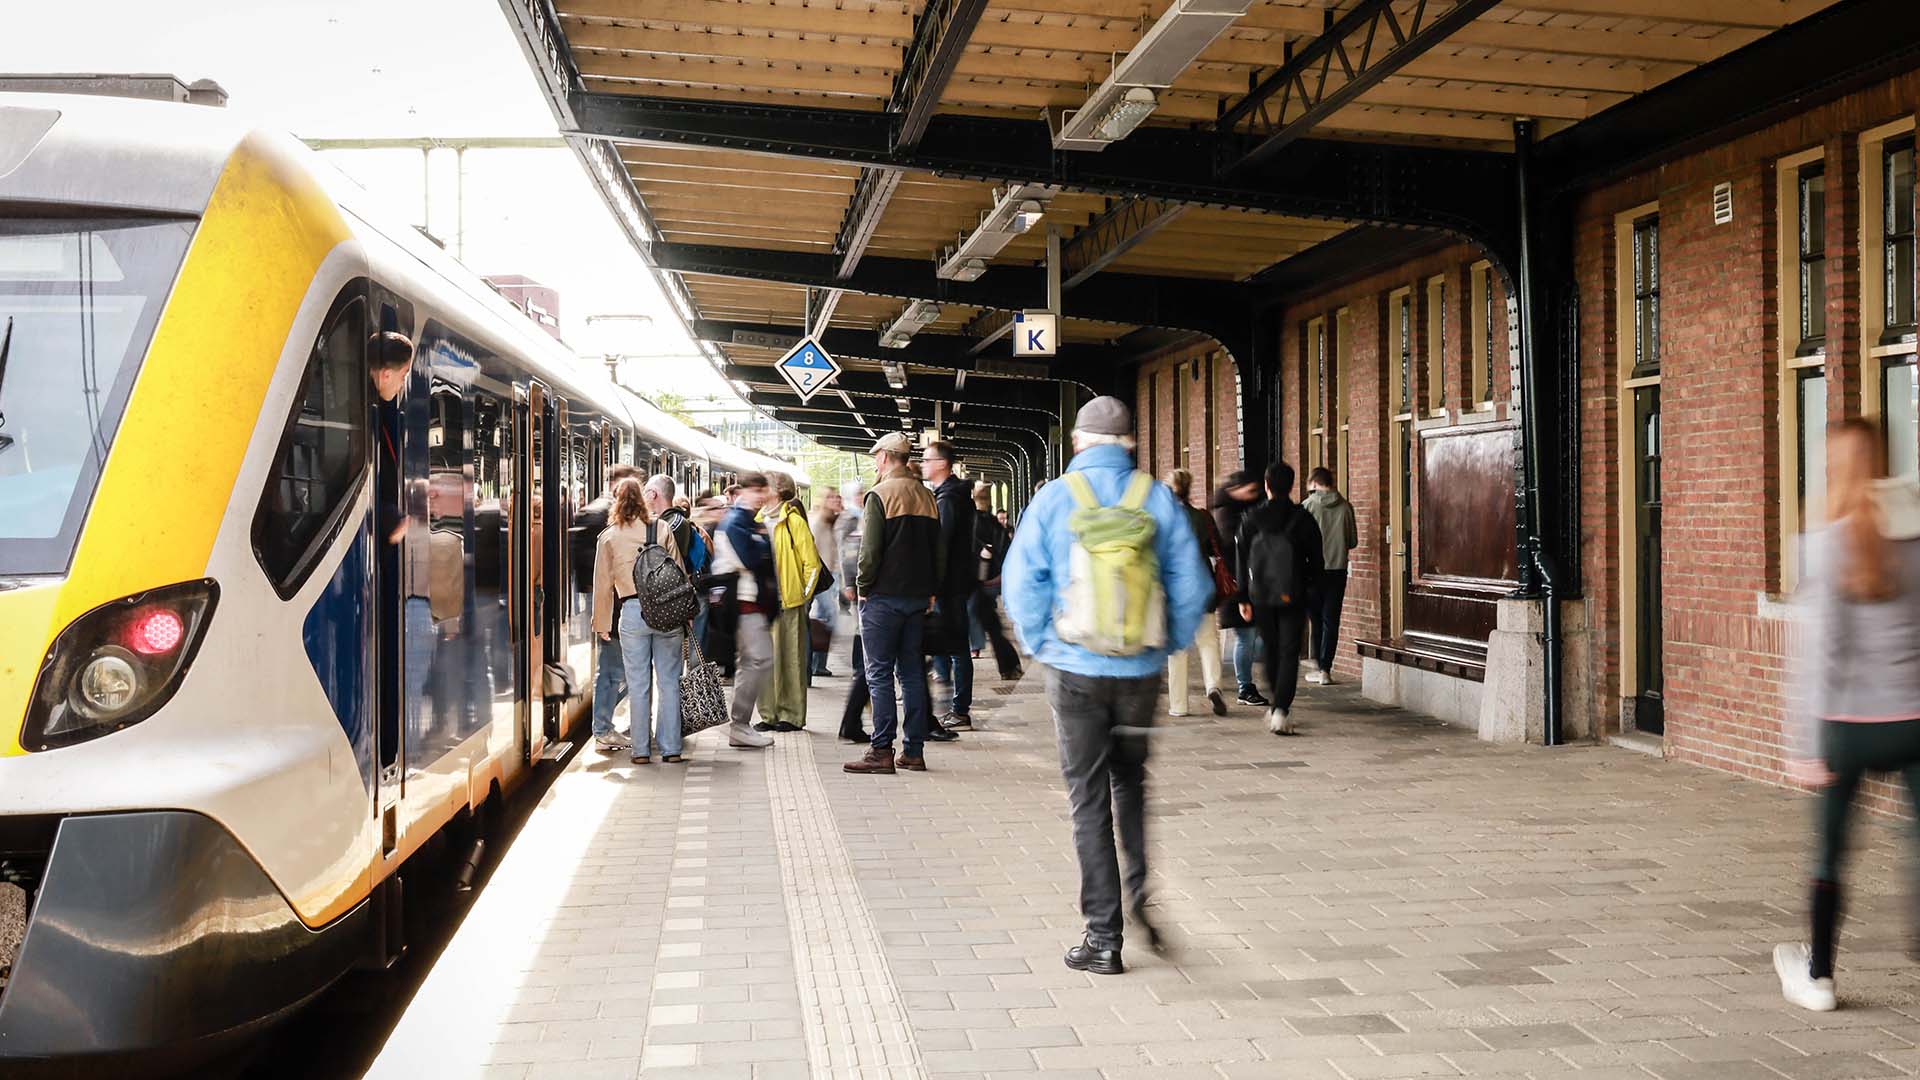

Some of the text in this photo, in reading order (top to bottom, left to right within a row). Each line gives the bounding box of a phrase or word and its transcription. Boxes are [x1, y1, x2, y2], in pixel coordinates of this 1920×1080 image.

[1028, 329, 1045, 351] K
[804, 351, 814, 366] 8
[803, 372, 813, 386] 2
